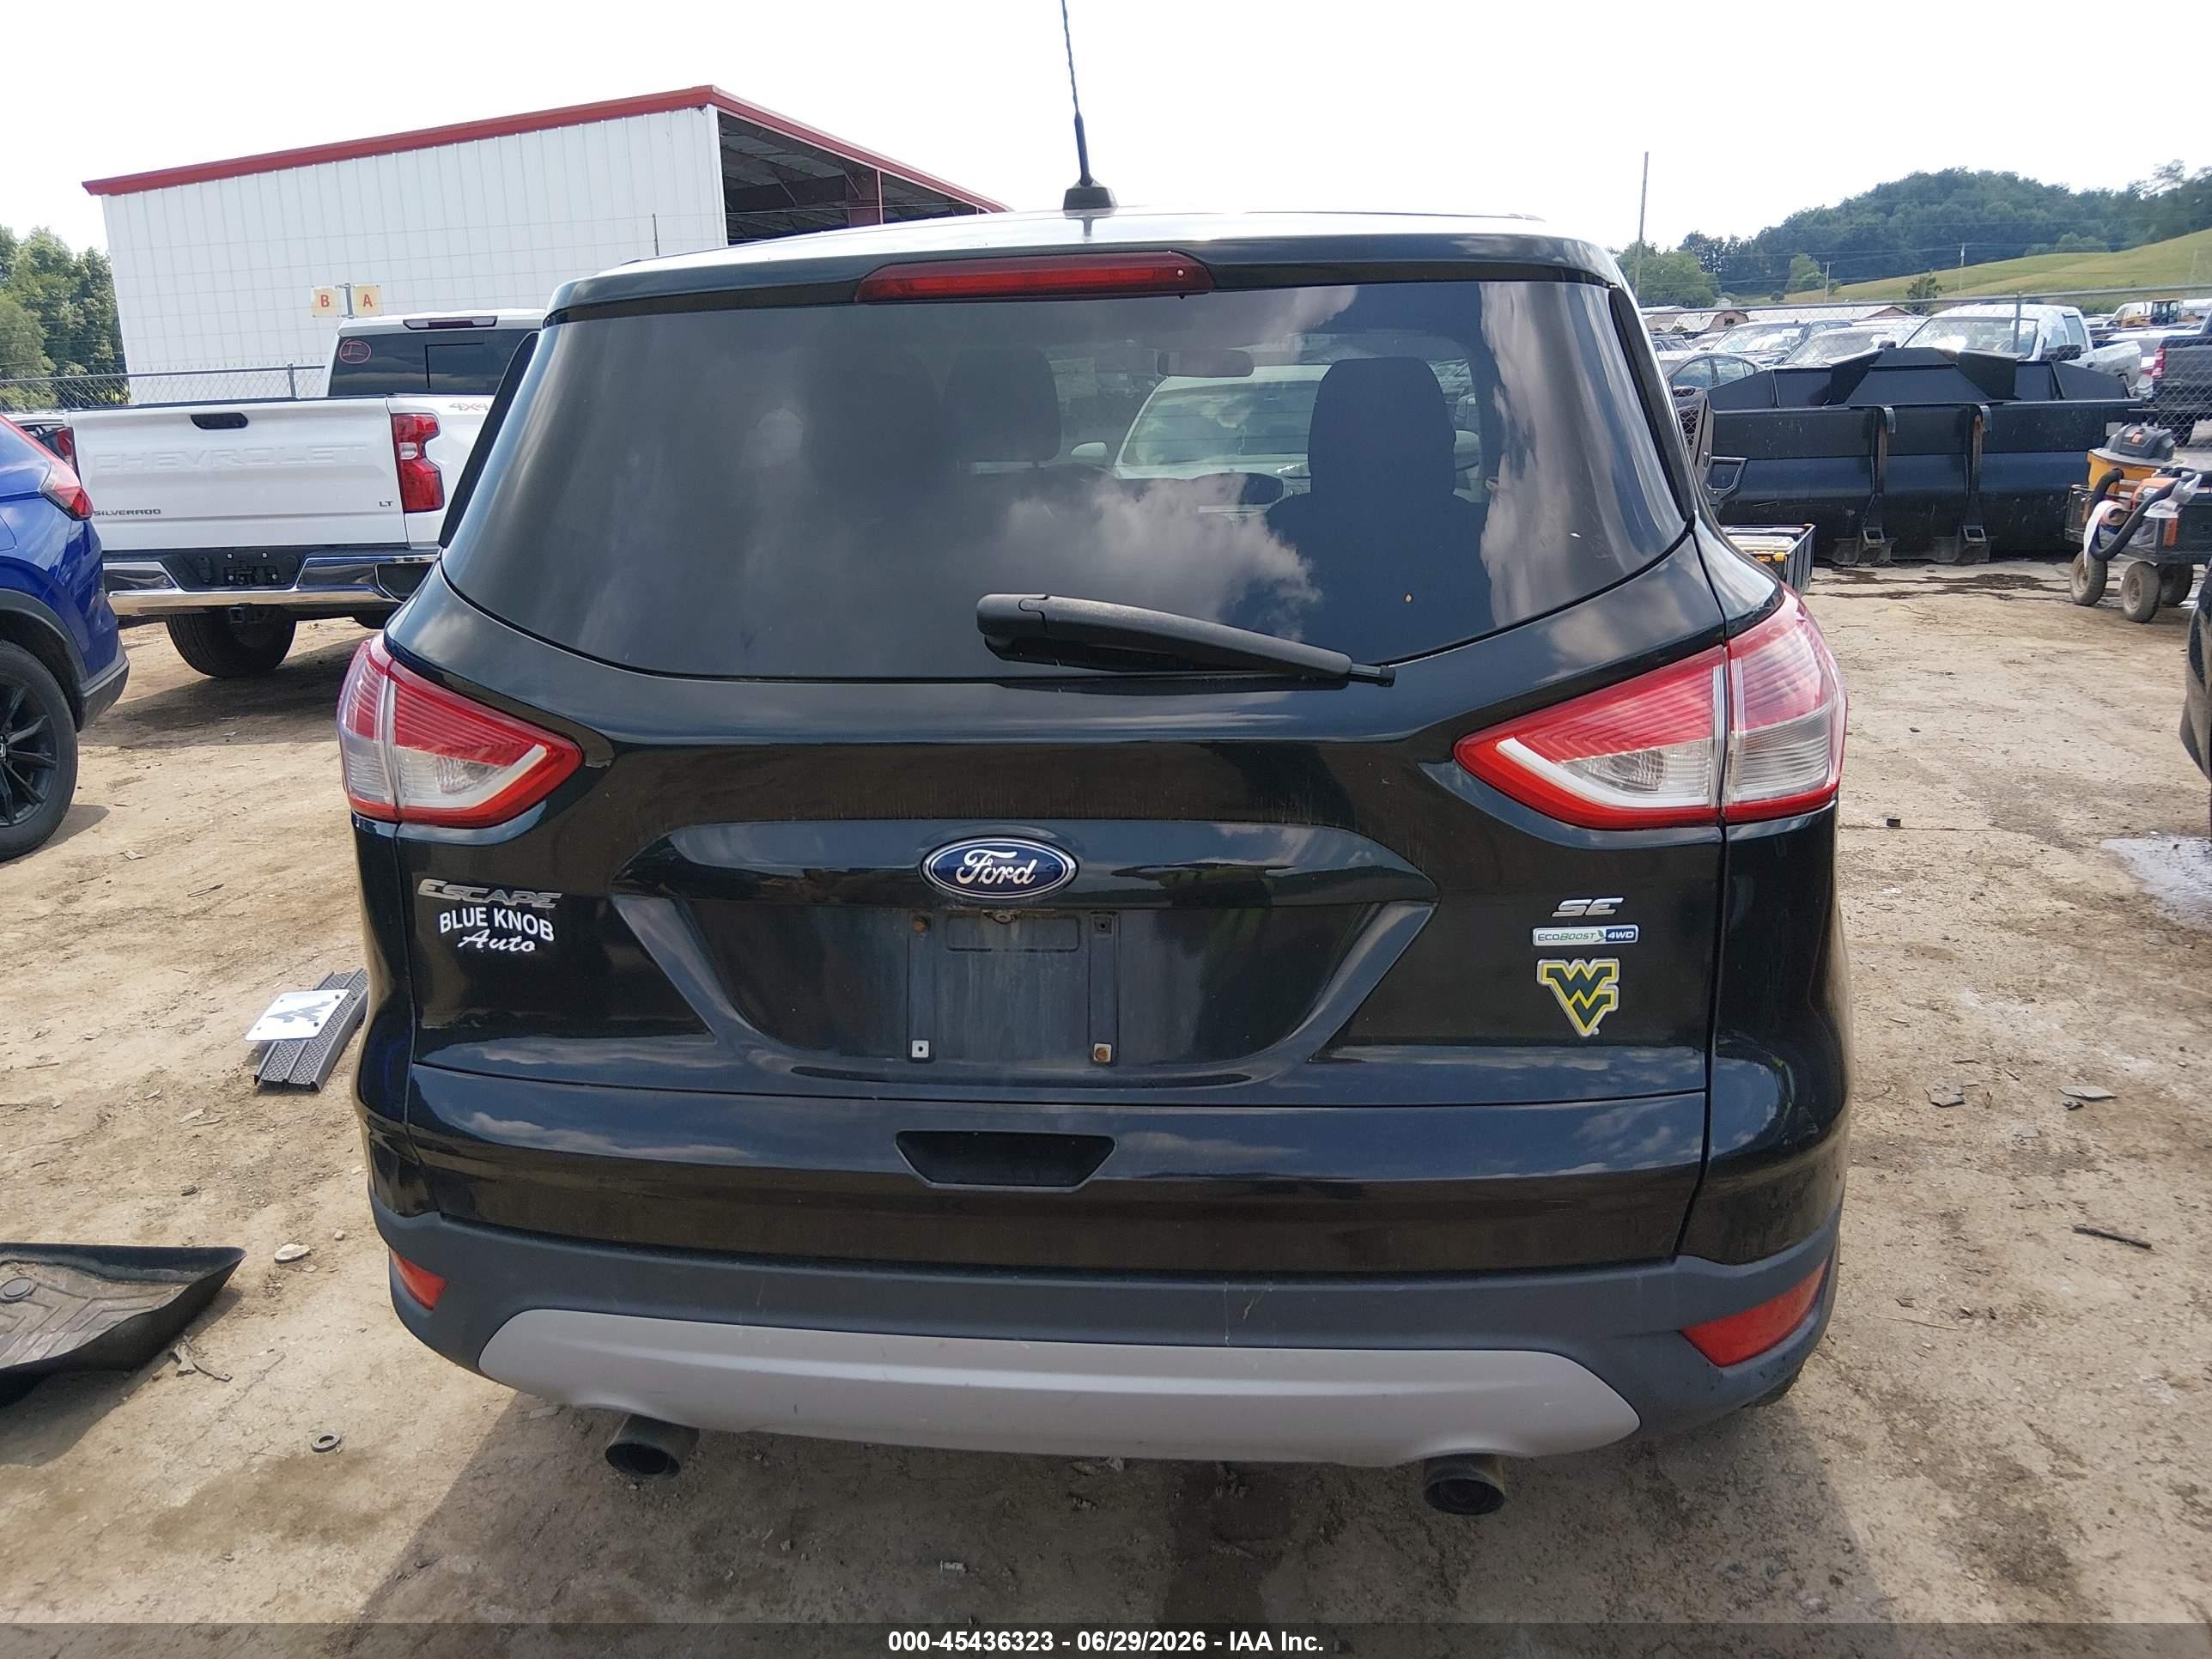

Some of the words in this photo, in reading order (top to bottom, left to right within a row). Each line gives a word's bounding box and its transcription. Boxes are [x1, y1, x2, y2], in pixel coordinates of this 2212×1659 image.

[320, 295, 331, 307] B
[362, 295, 374, 307] A
[93, 443, 368, 471] CHEVROLET
[956, 848, 1038, 884] Ford
[417, 878, 562, 908] ESCAPE
[1552, 897, 1624, 917] SE
[440, 907, 489, 933] BLUE
[494, 907, 555, 941] KNOB
[1607, 930, 1635, 939] 4WD
[457, 928, 536, 952] Auto
